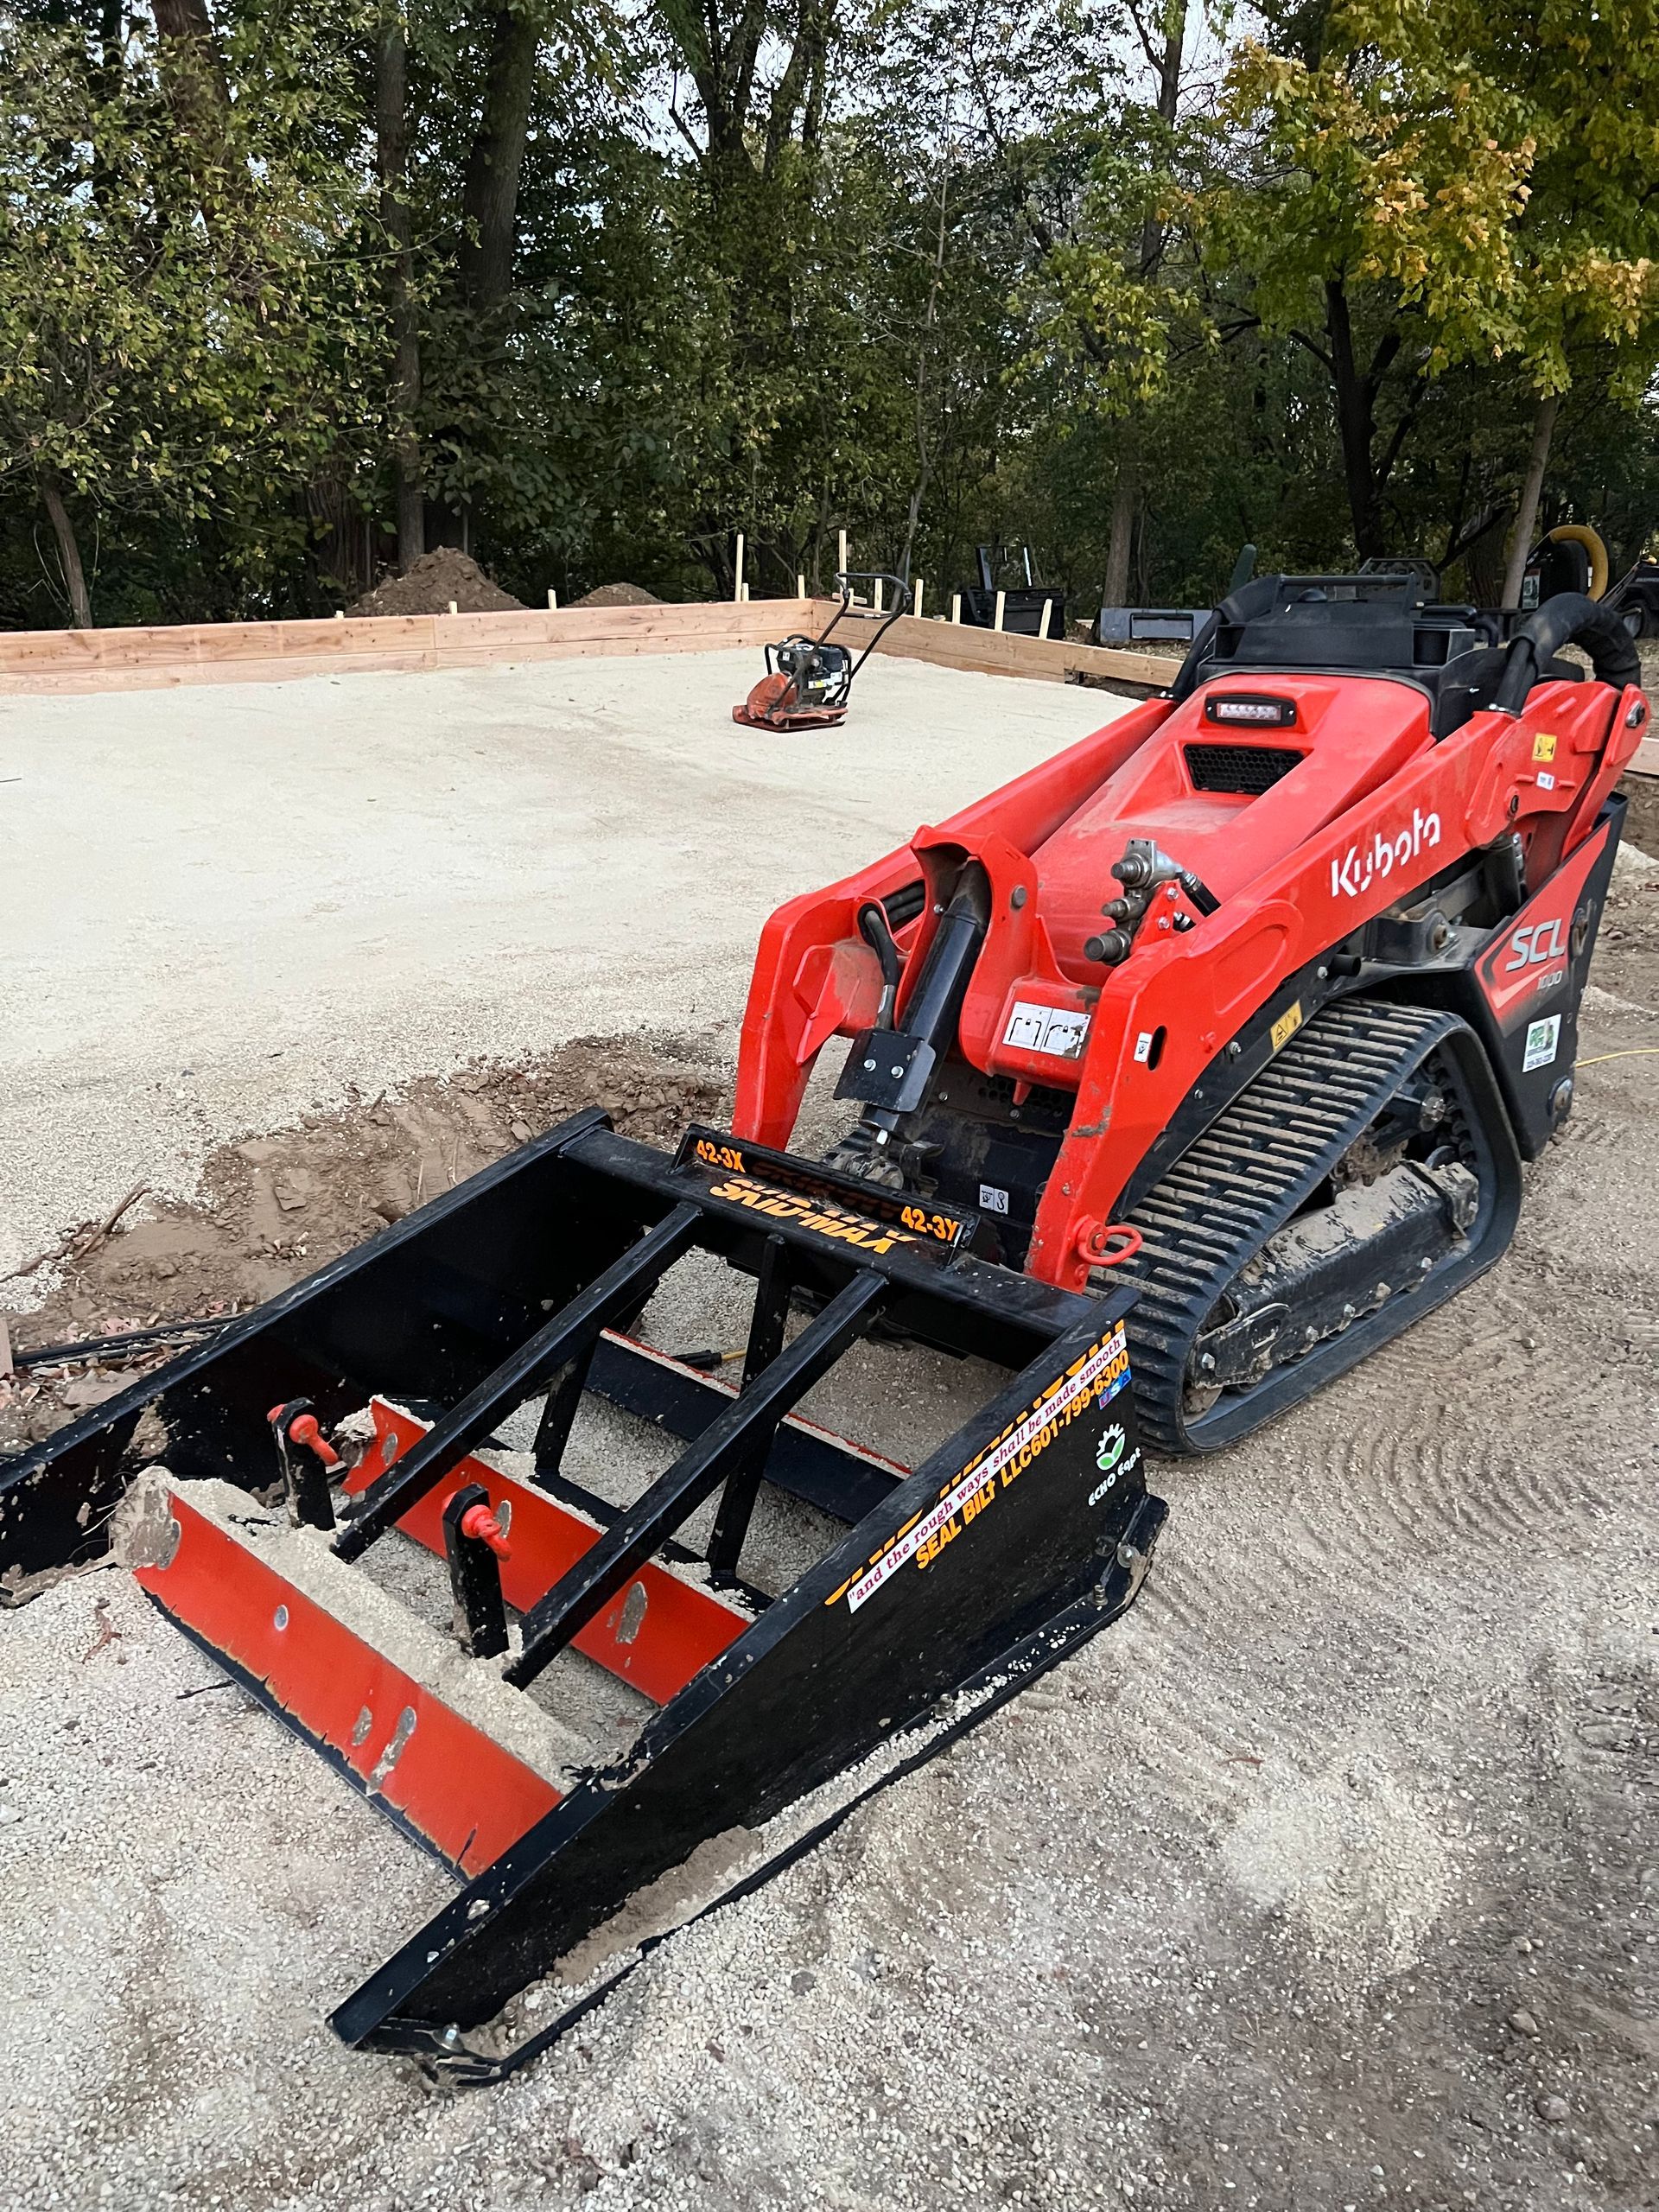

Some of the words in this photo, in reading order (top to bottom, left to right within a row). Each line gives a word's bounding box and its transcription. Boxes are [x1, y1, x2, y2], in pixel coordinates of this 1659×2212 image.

[1332, 808, 1440, 897] Kubota
[1505, 918, 1565, 972] SCL
[696, 1139, 746, 1173] 42-3X
[900, 1206, 958, 1242] 42-3Y
[1099, 1371, 1130, 1408] USA
[887, 1542, 910, 1569] the
[914, 1501, 953, 1544] rough
[957, 1467, 988, 1502] ways
[993, 1428, 1025, 1467] shall
[1027, 1414, 1042, 1434] be
[1044, 1382, 1077, 1418] made
[916, 1516, 962, 1570] SEAL
